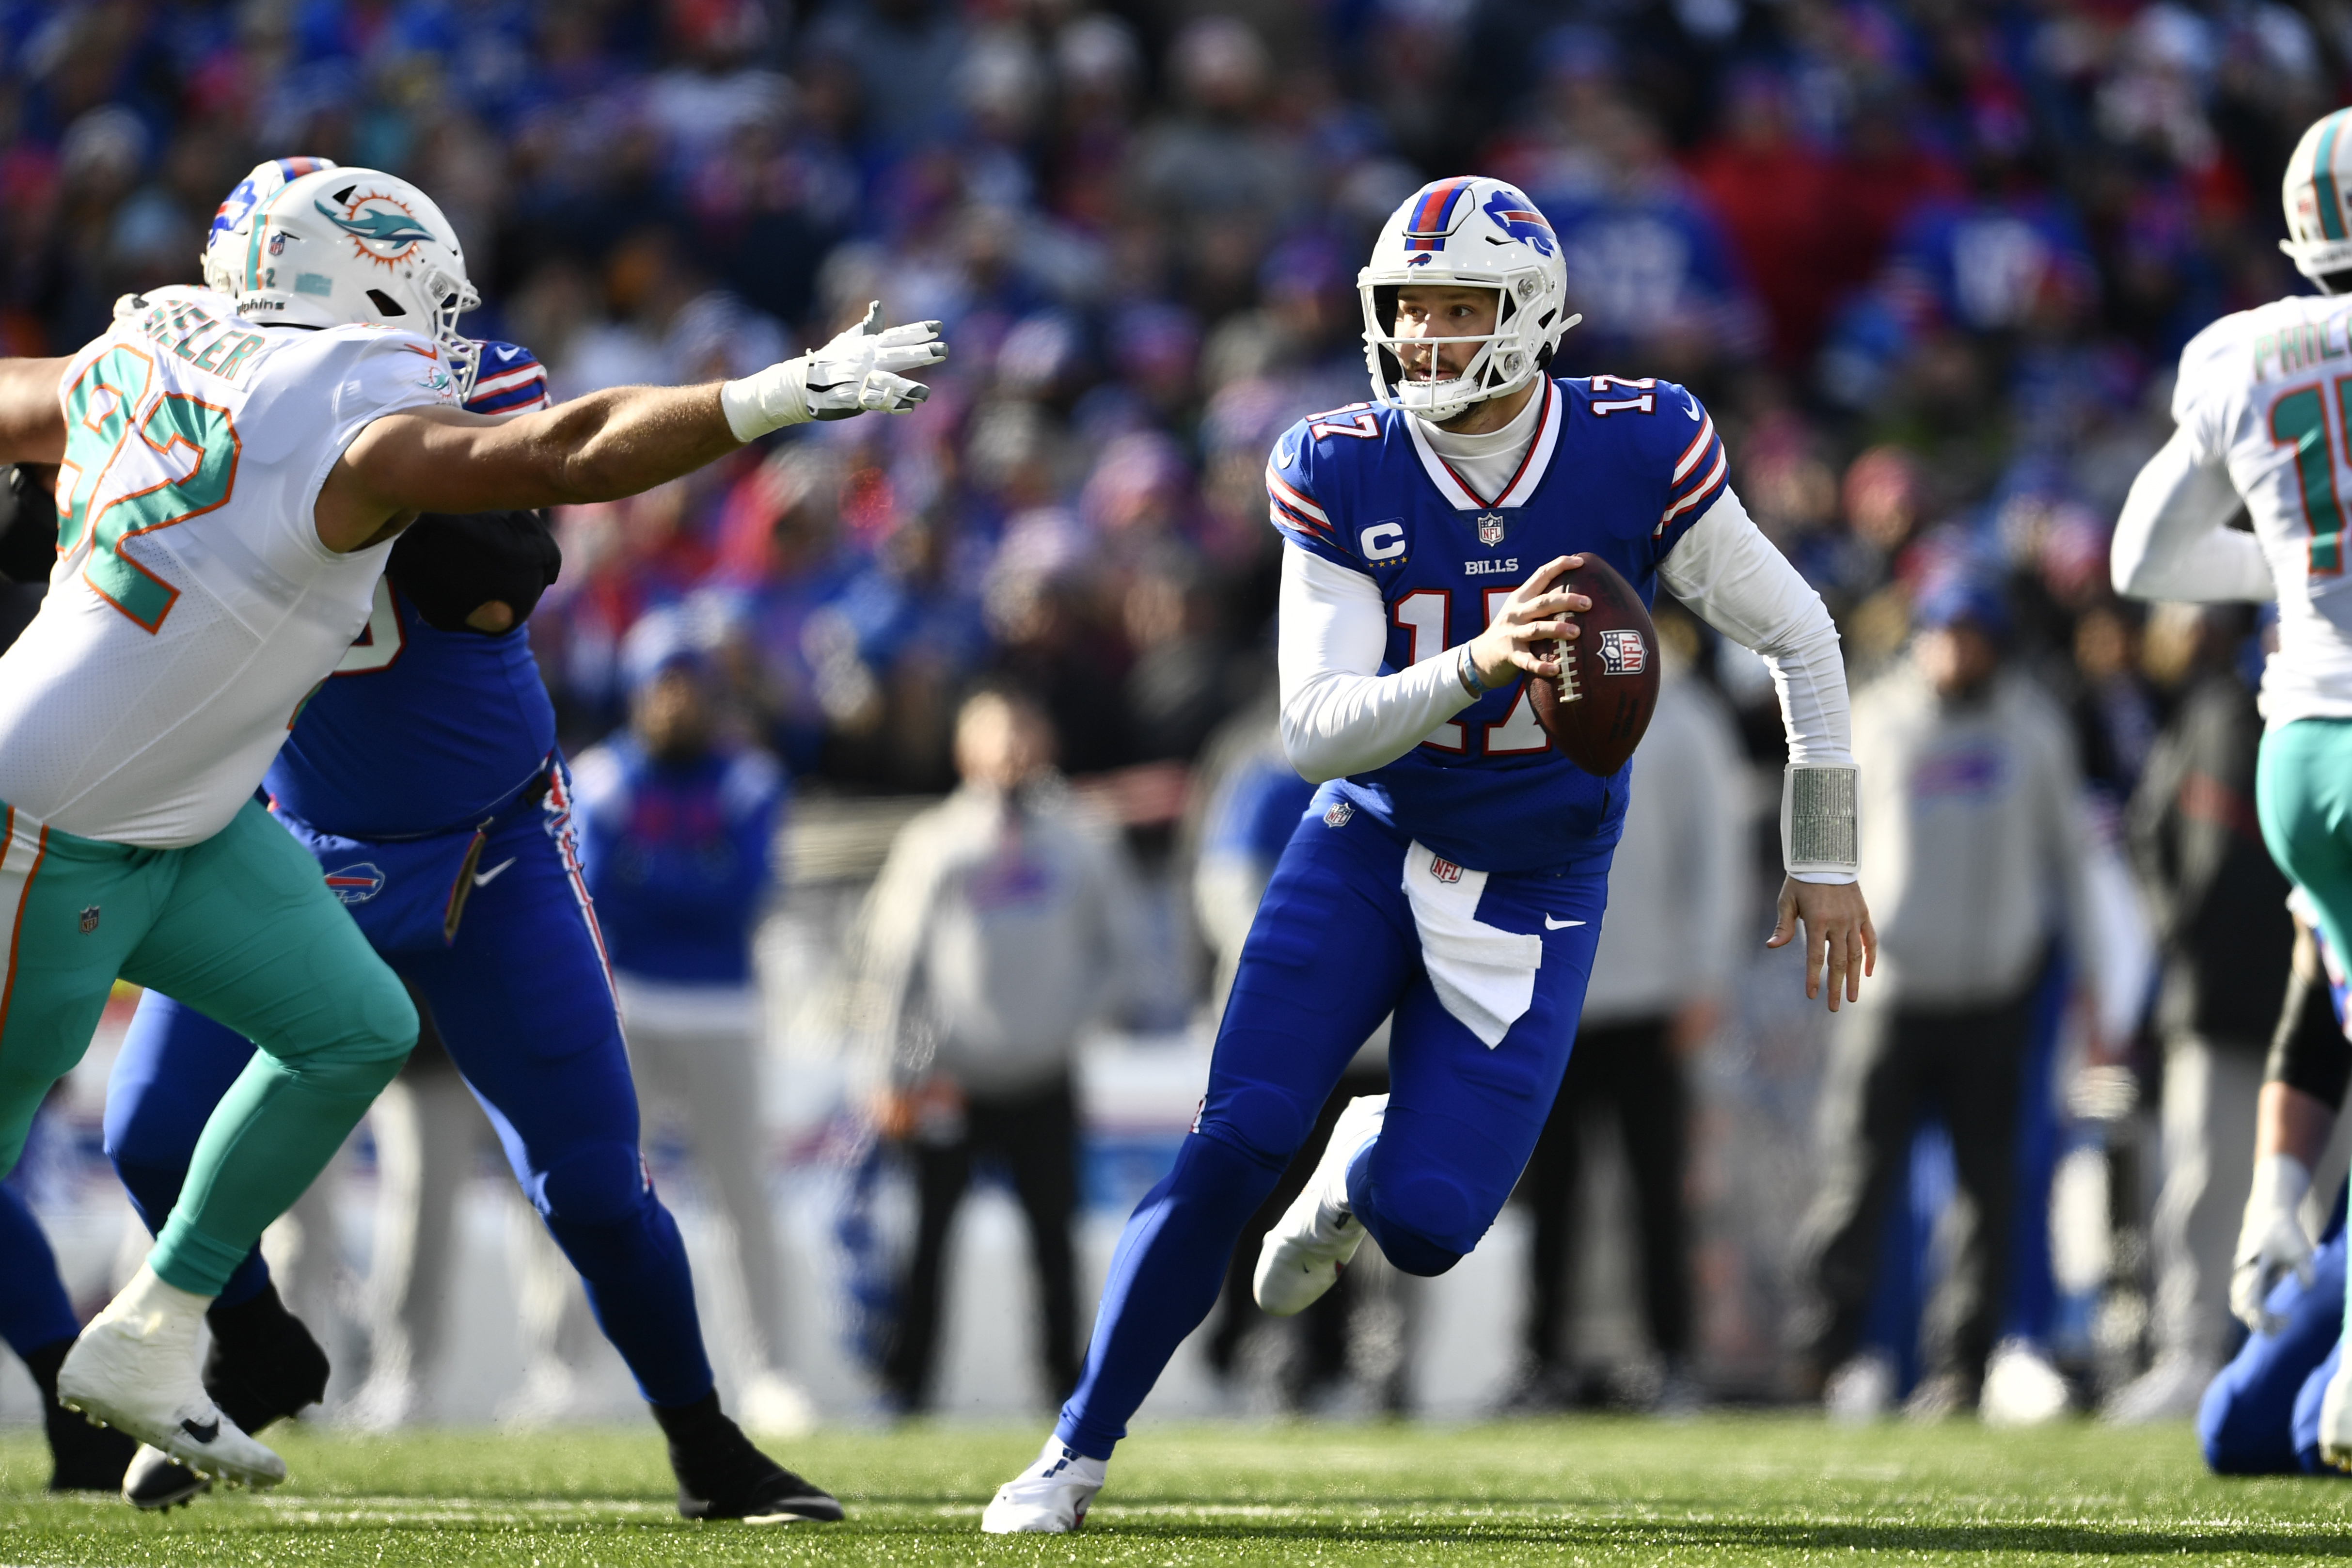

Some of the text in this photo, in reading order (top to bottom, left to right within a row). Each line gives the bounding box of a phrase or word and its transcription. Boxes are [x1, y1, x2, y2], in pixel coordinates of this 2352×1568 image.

[2254, 315, 2352, 382] PHIL
[1590, 375, 1656, 416] 17
[1305, 402, 1381, 442] 17
[55, 343, 241, 635] 92
[1360, 523, 1405, 560] C
[1483, 527, 1500, 540] NFL
[1465, 558, 1519, 575] BILLS
[1622, 634, 1642, 669] NFL
[1327, 812, 1345, 823] NFL
[1432, 858, 1459, 881] NFL
